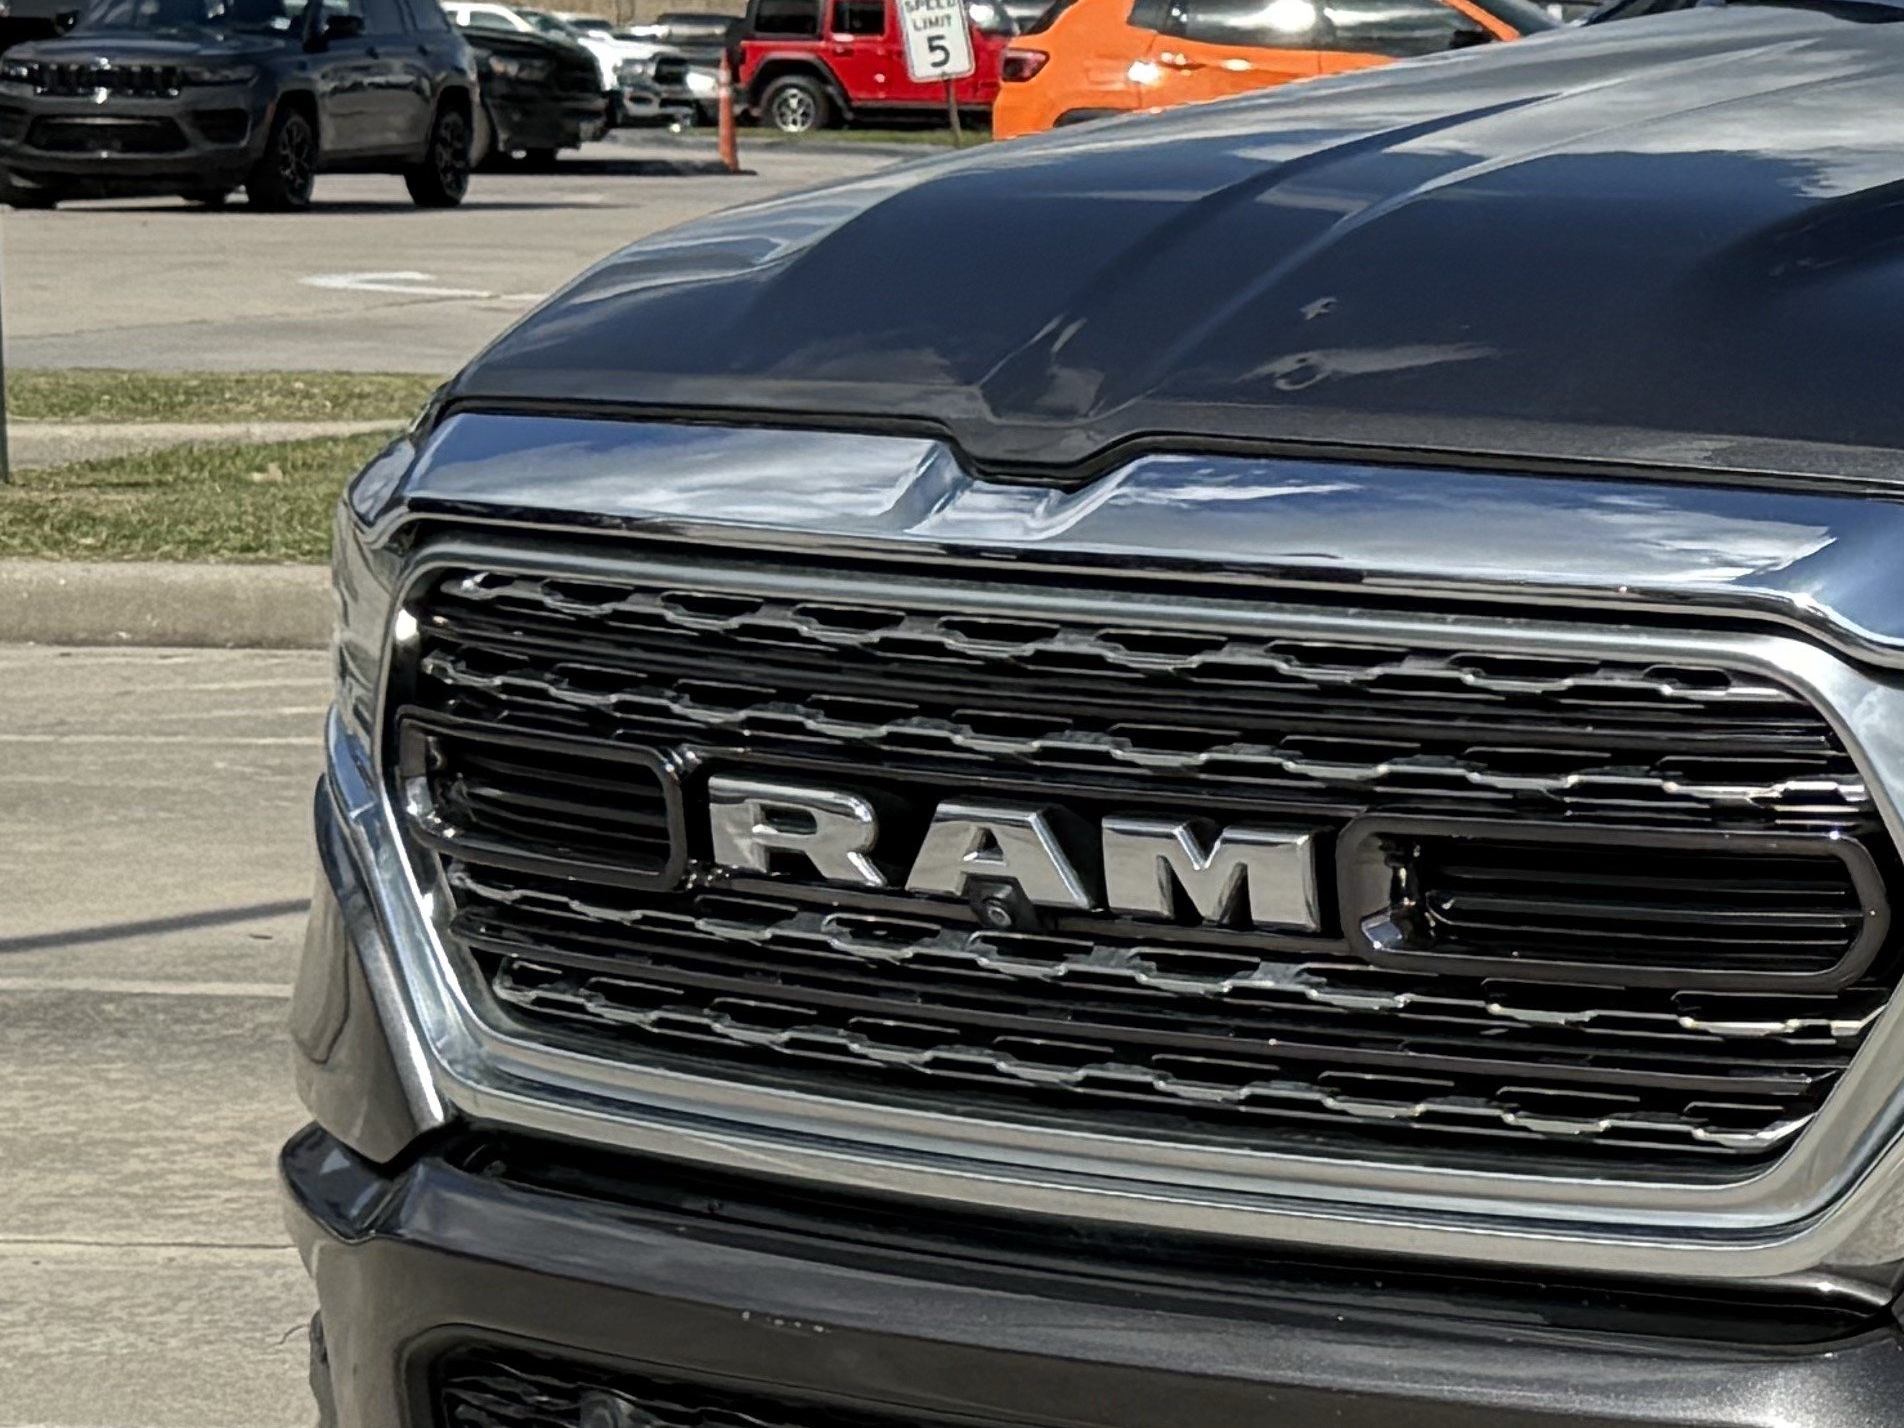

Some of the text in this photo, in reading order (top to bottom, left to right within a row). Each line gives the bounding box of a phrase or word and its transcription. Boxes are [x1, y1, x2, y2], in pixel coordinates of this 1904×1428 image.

[913, 14, 951, 31] LIMIT
[927, 34, 951, 68] 5
[708, 774, 1322, 933] RAM
